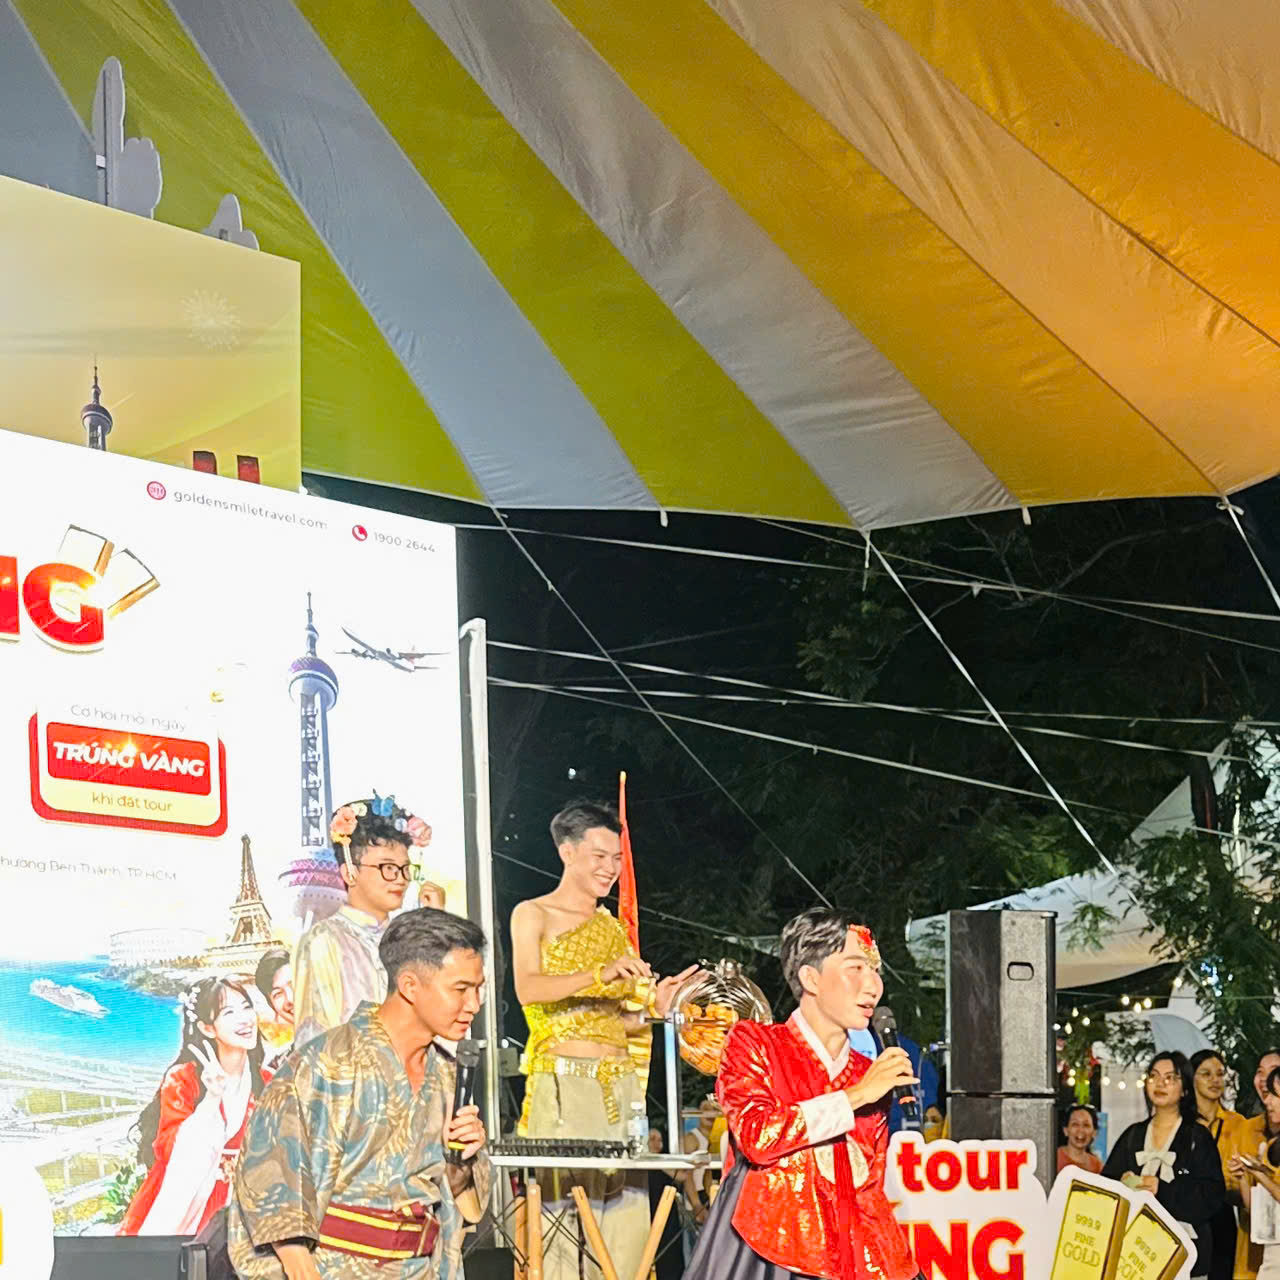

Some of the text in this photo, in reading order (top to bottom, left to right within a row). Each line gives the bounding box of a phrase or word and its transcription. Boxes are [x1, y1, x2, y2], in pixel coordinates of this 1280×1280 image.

[374, 531, 436, 553] 1900 2644
[0, 555, 104, 645] G
[139, 750, 206, 777] VÀNG
[91, 791, 113, 806] khi
[144, 799, 173, 812] tour
[897, 1142, 1028, 1192] tour
[1075, 1214, 1102, 1231] 999.9
[1074, 1232, 1096, 1247] FINE
[1062, 1242, 1100, 1268] GOLD
[1128, 1252, 1147, 1274] FINE
